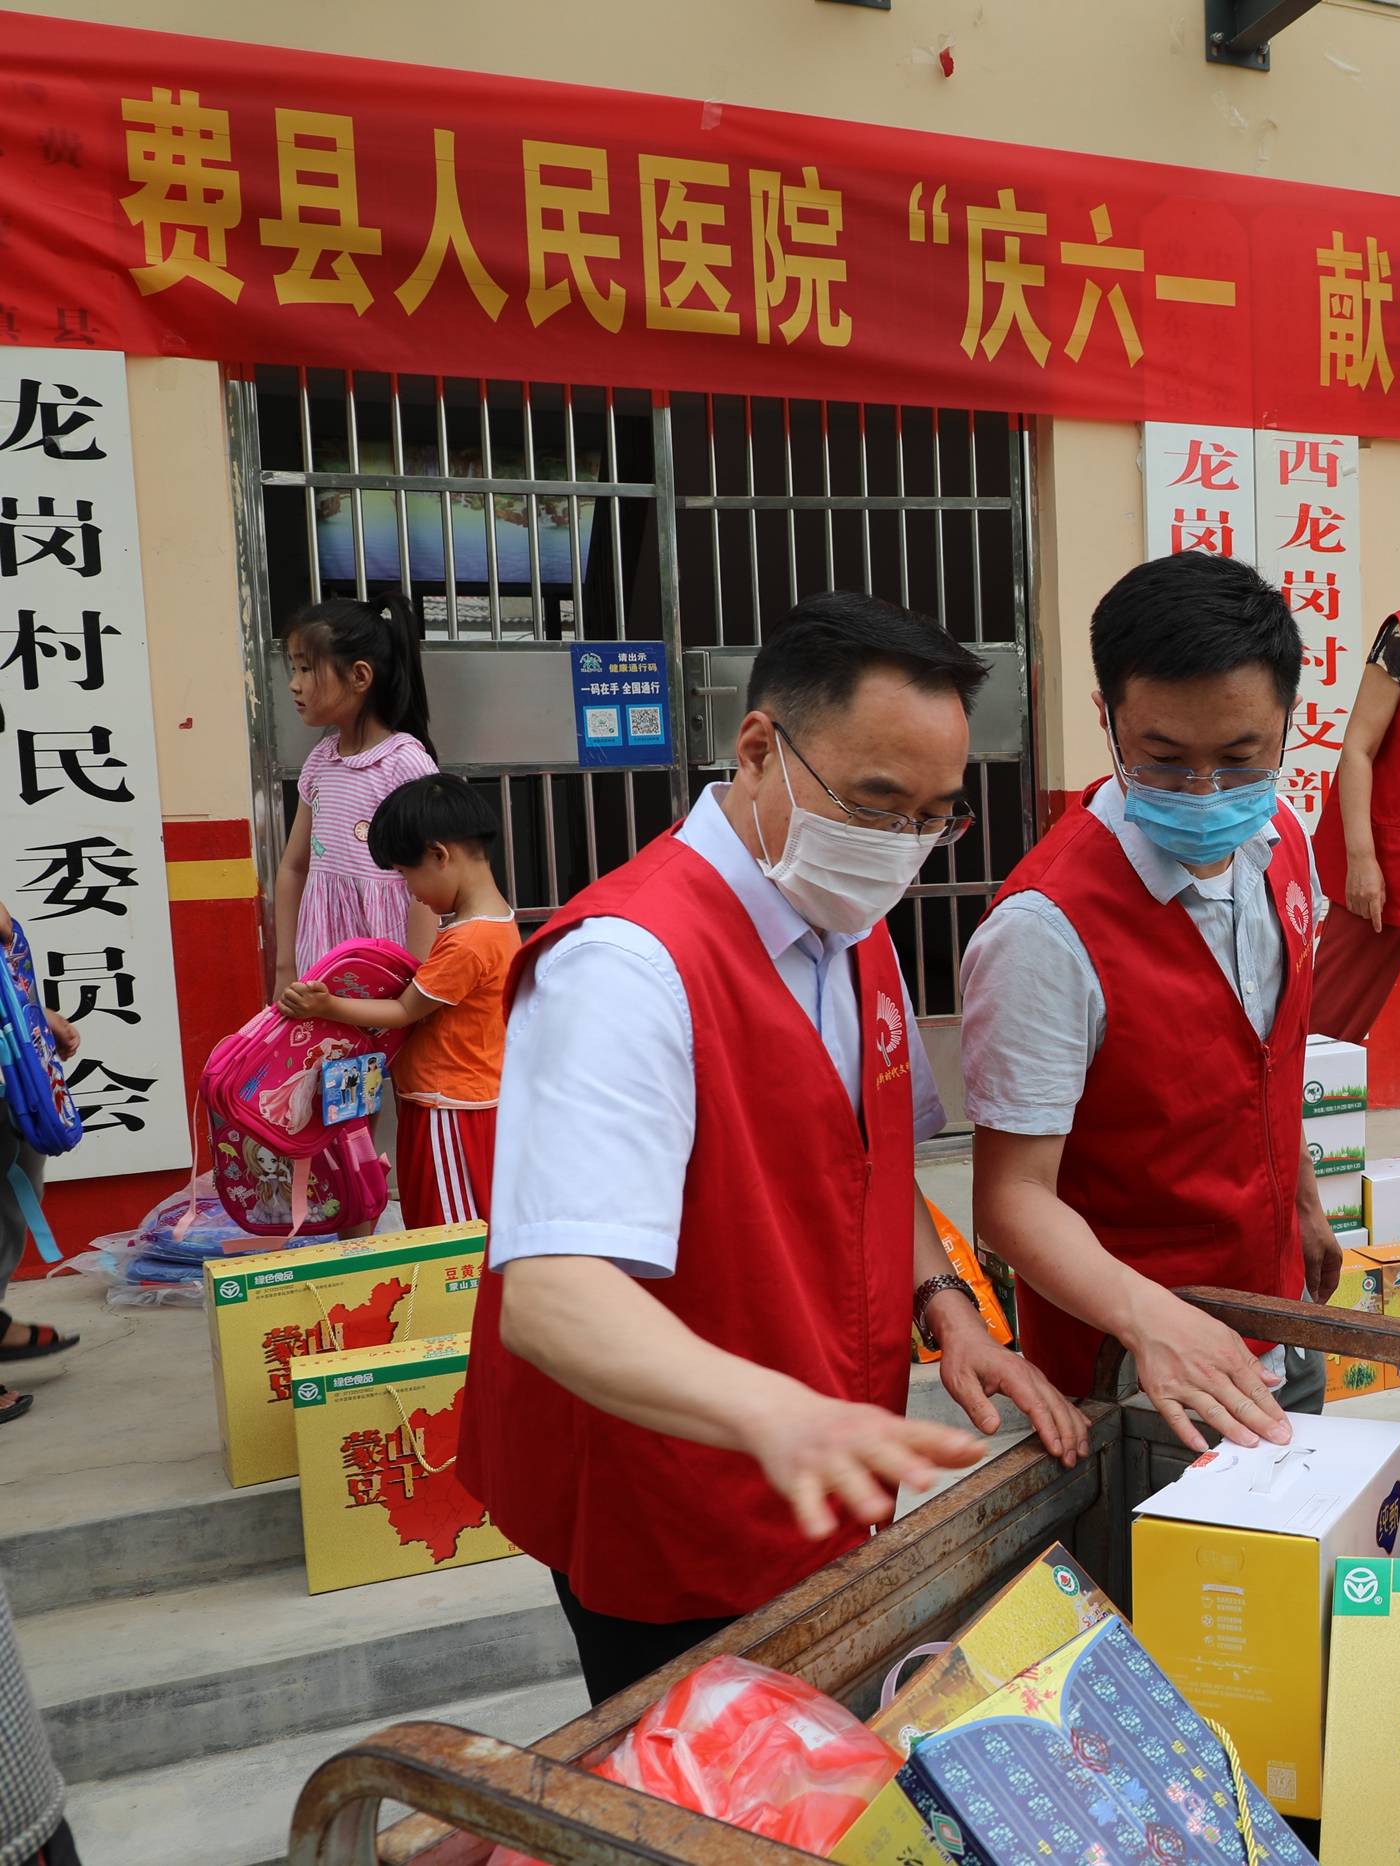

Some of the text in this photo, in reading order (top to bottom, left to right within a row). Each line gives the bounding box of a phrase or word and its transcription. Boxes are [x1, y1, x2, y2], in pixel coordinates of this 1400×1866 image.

[1163, 438, 1240, 558] 龙岗
[581, 681, 661, 696] 一码在手 全国通行
[618, 652, 648, 662] 请出示
[0, 377, 160, 1134] 龙岗村民委员会
